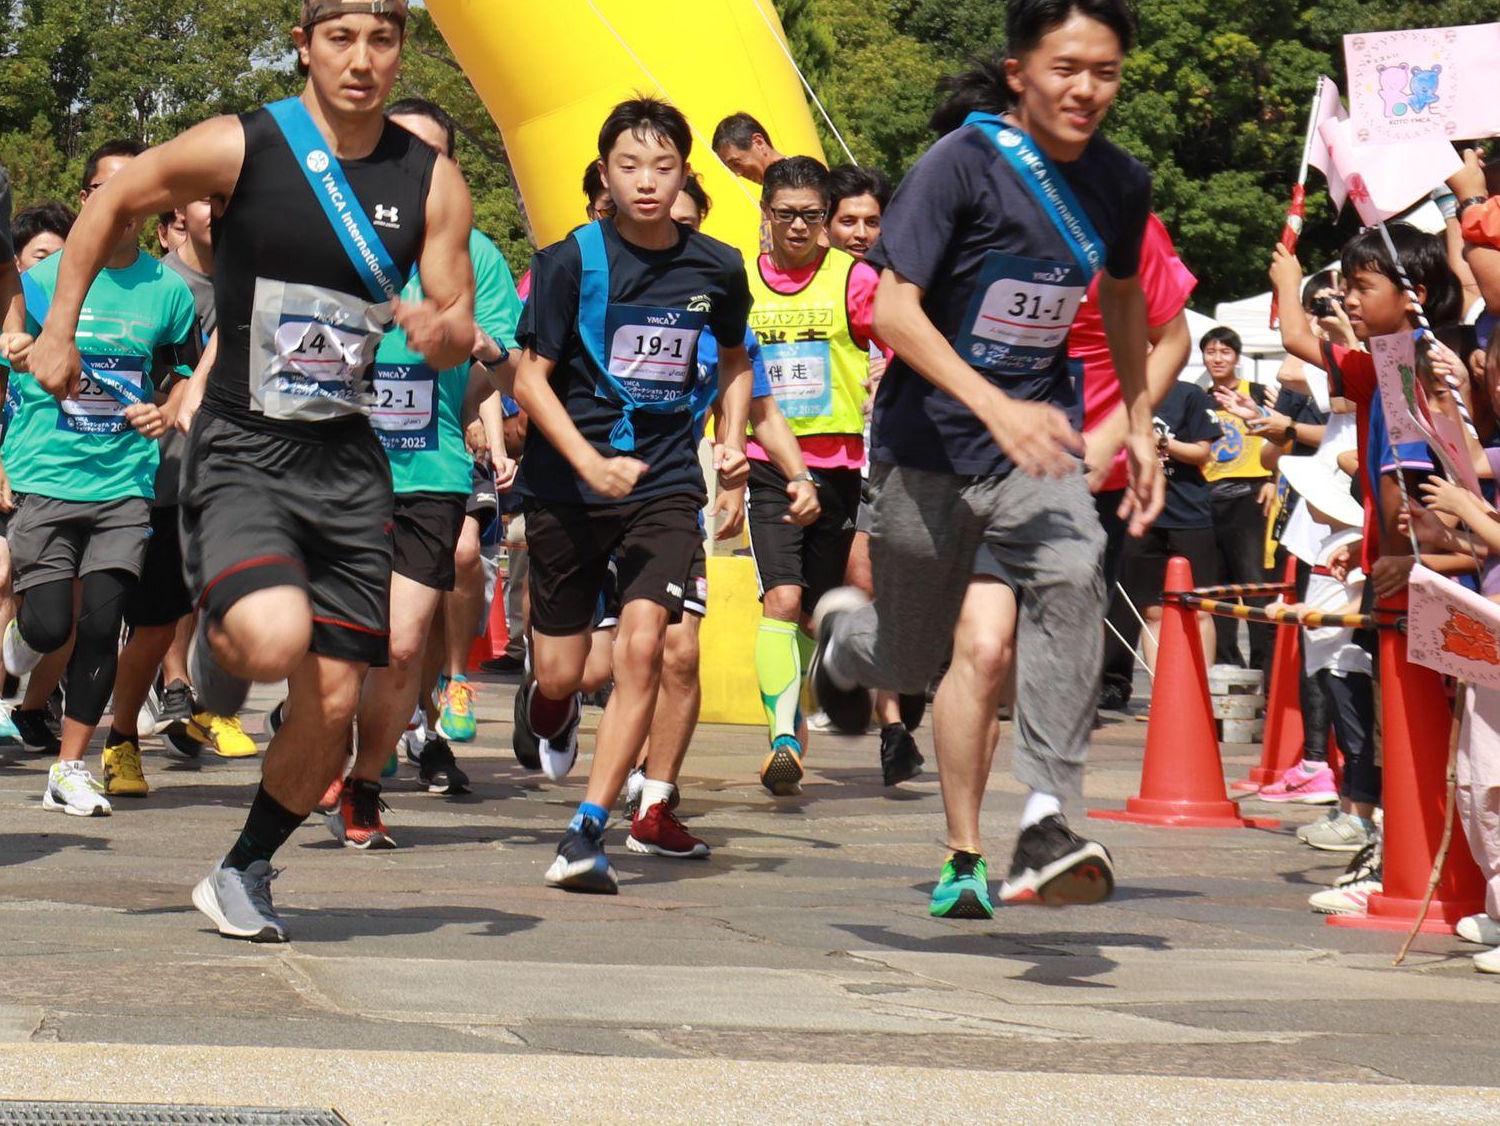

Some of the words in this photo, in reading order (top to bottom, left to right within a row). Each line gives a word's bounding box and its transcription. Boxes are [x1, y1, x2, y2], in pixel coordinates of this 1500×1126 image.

[1016, 145, 1048, 180] YMCA
[321, 172, 347, 213] YMCA
[341, 210, 392, 290] International
[1008, 292, 1067, 321] 31-1
[646, 316, 670, 326] YMCA
[634, 335, 683, 358] 19-1
[90, 361, 110, 369] YMCA
[377, 370, 400, 379] YMCA
[400, 436, 427, 449] 2025
